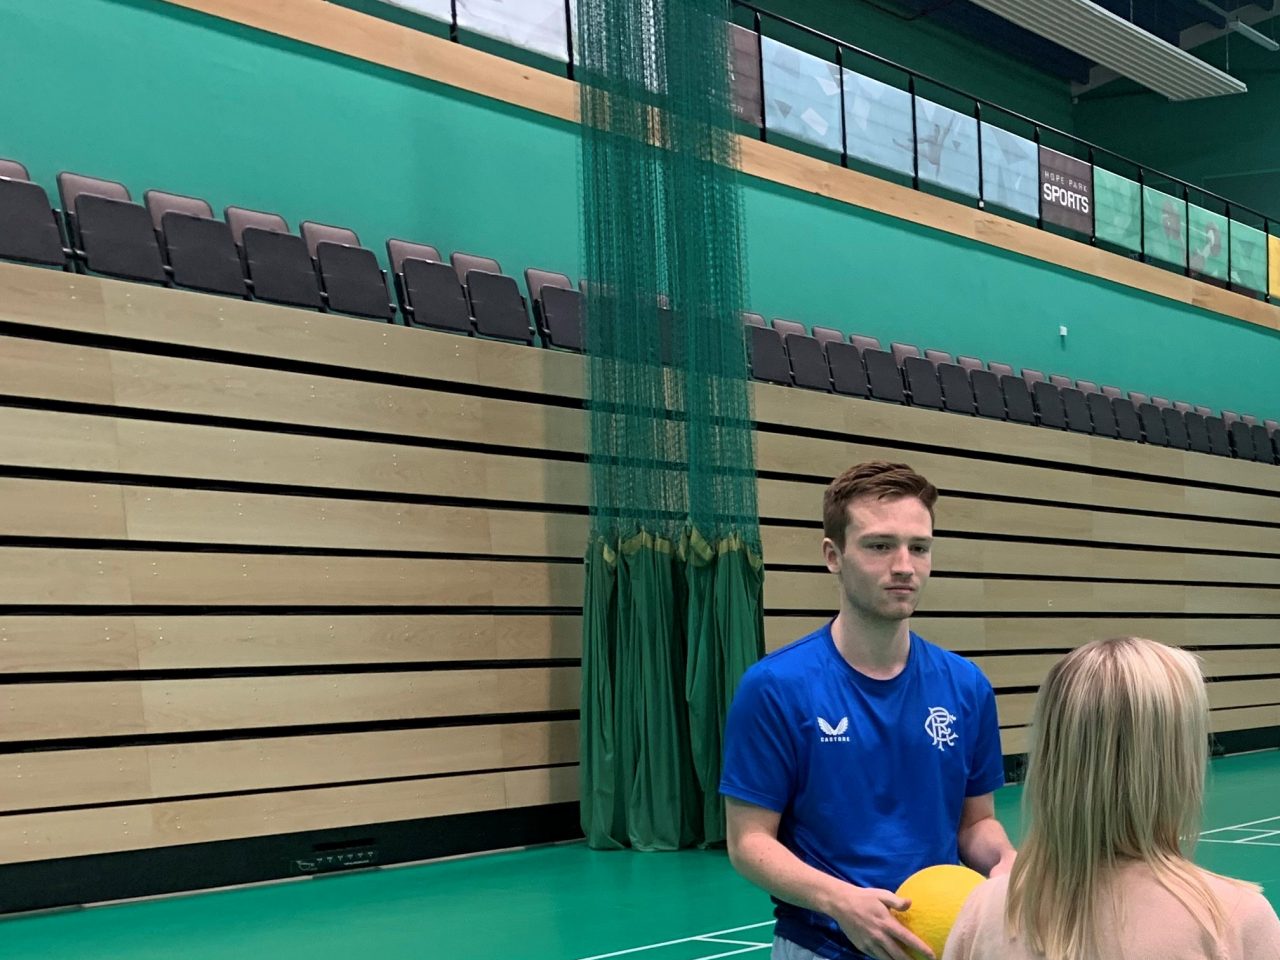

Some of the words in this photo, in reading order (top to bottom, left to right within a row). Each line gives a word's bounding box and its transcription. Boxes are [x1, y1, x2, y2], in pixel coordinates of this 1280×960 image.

[1044, 170, 1065, 185] HOPE
[1068, 179, 1088, 193] PARK
[1043, 182, 1089, 213] SPORTS
